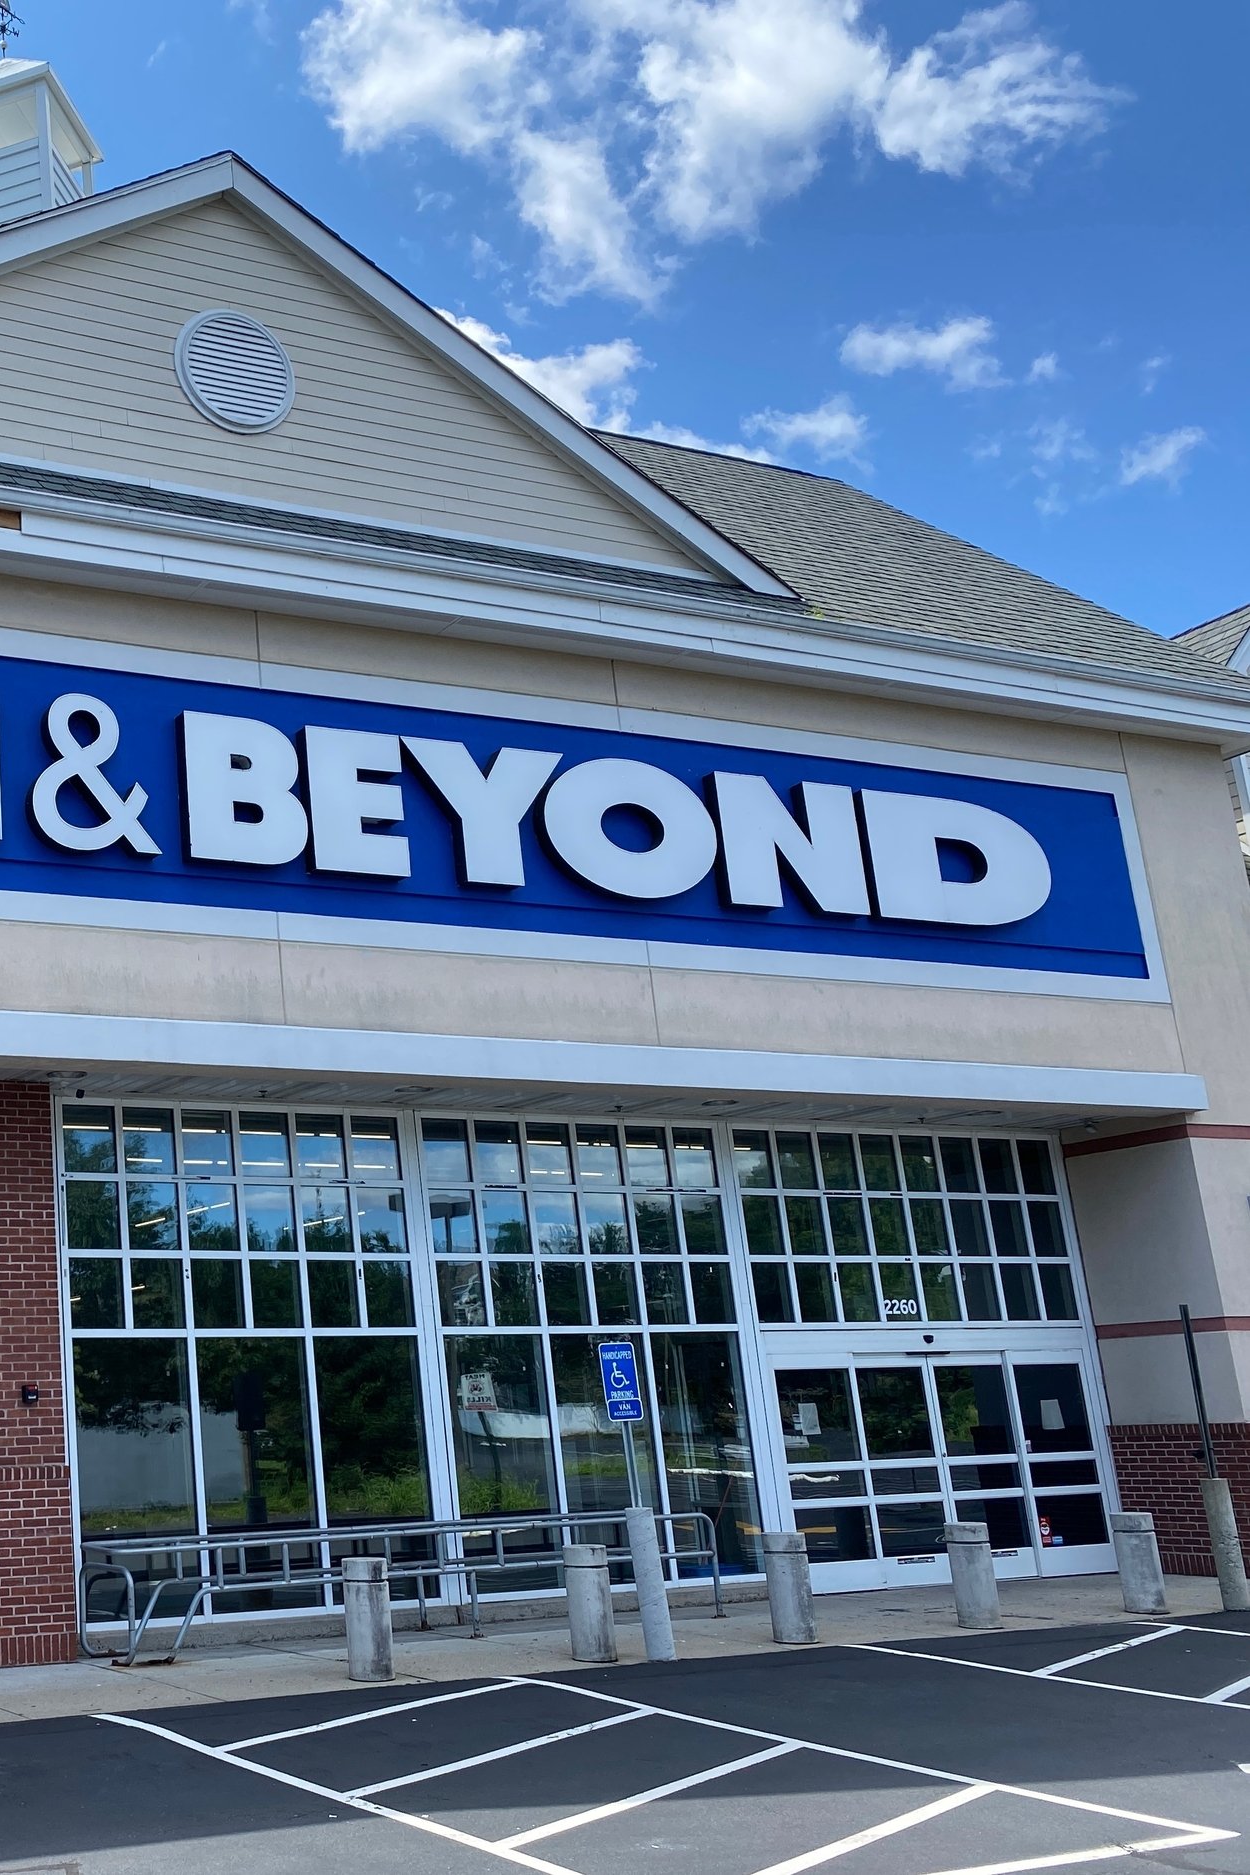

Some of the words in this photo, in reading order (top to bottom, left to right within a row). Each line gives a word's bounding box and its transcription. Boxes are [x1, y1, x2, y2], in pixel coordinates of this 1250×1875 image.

[32, 693, 163, 856] &
[181, 710, 1052, 927] BEYOND
[884, 1299, 917, 1315] 2260
[602, 1351, 632, 1360] HANDICAPPED
[611, 1390, 634, 1399] PARKING
